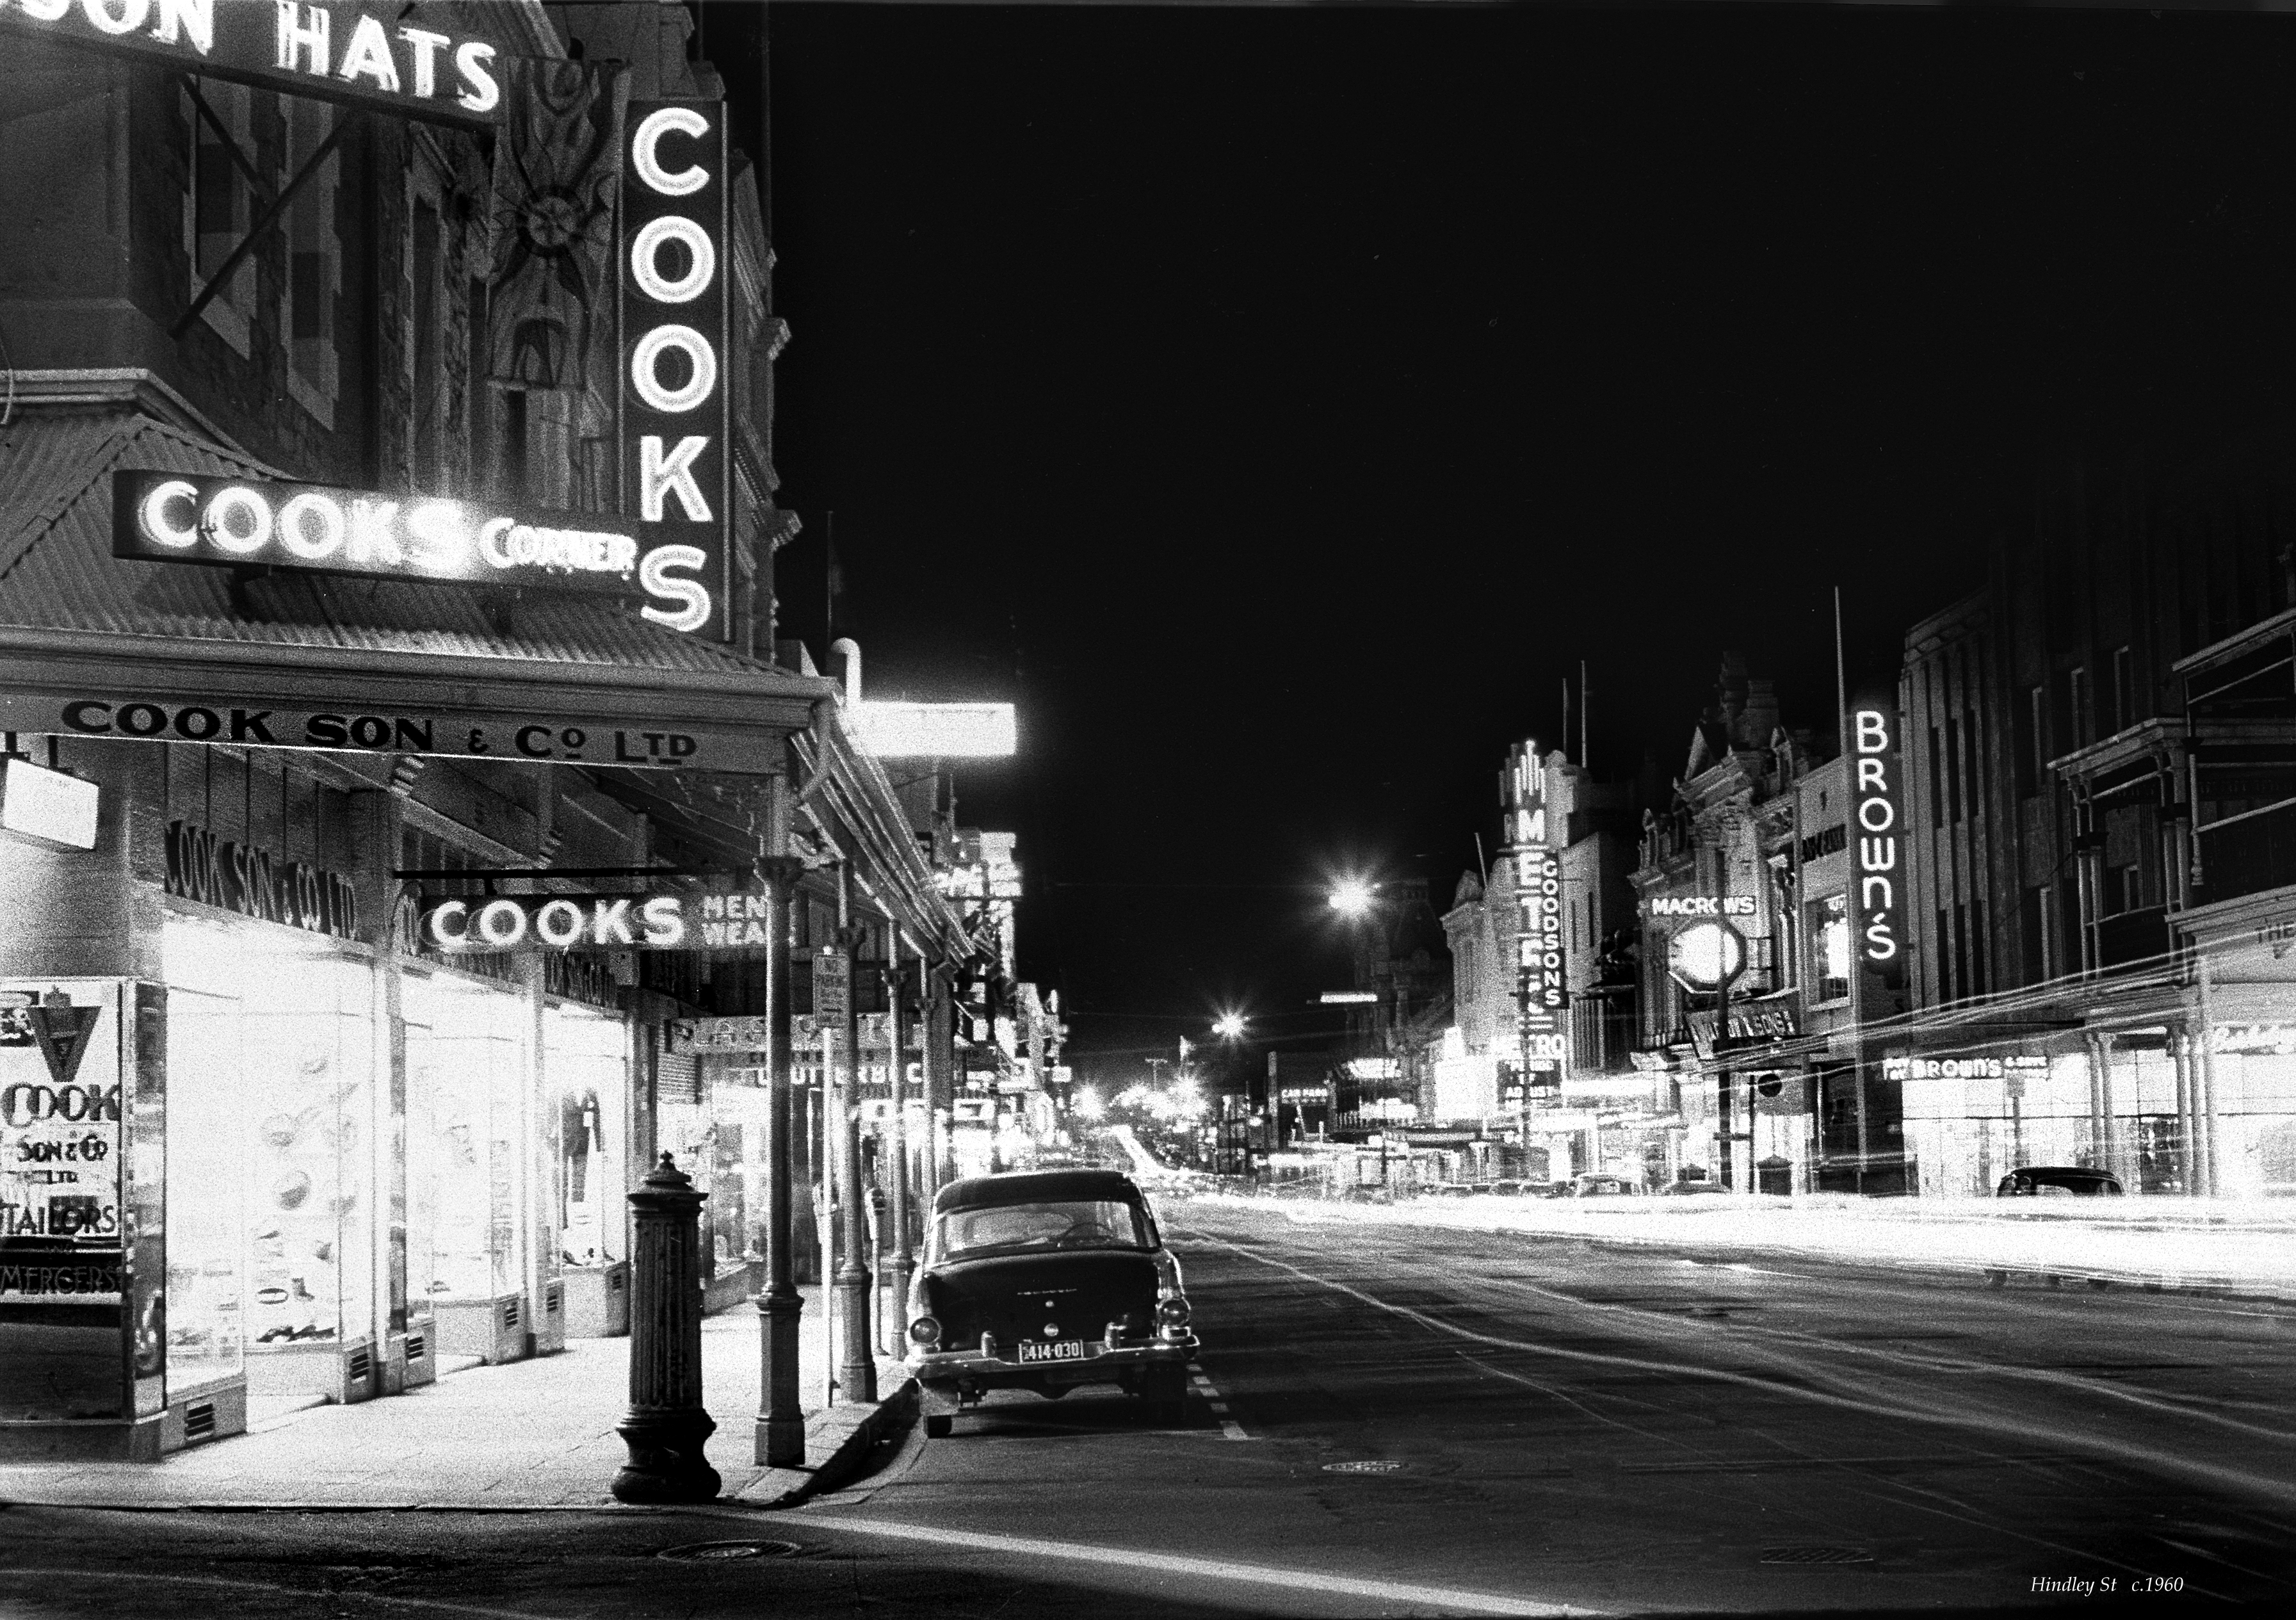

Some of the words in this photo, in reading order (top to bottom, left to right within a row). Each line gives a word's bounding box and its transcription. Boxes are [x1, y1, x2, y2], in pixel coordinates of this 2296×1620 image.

[274, 1, 501, 111] HATS
[631, 108, 716, 631] COOKS
[140, 480, 476, 579] COOKS
[61, 701, 275, 743] COOK
[306, 713, 433, 752] SON
[468, 728, 489, 754] &
[430, 898, 685, 946] COOKS
[1542, 860, 1561, 1007] GOODSONS
[1, 1082, 122, 1128] COOK
